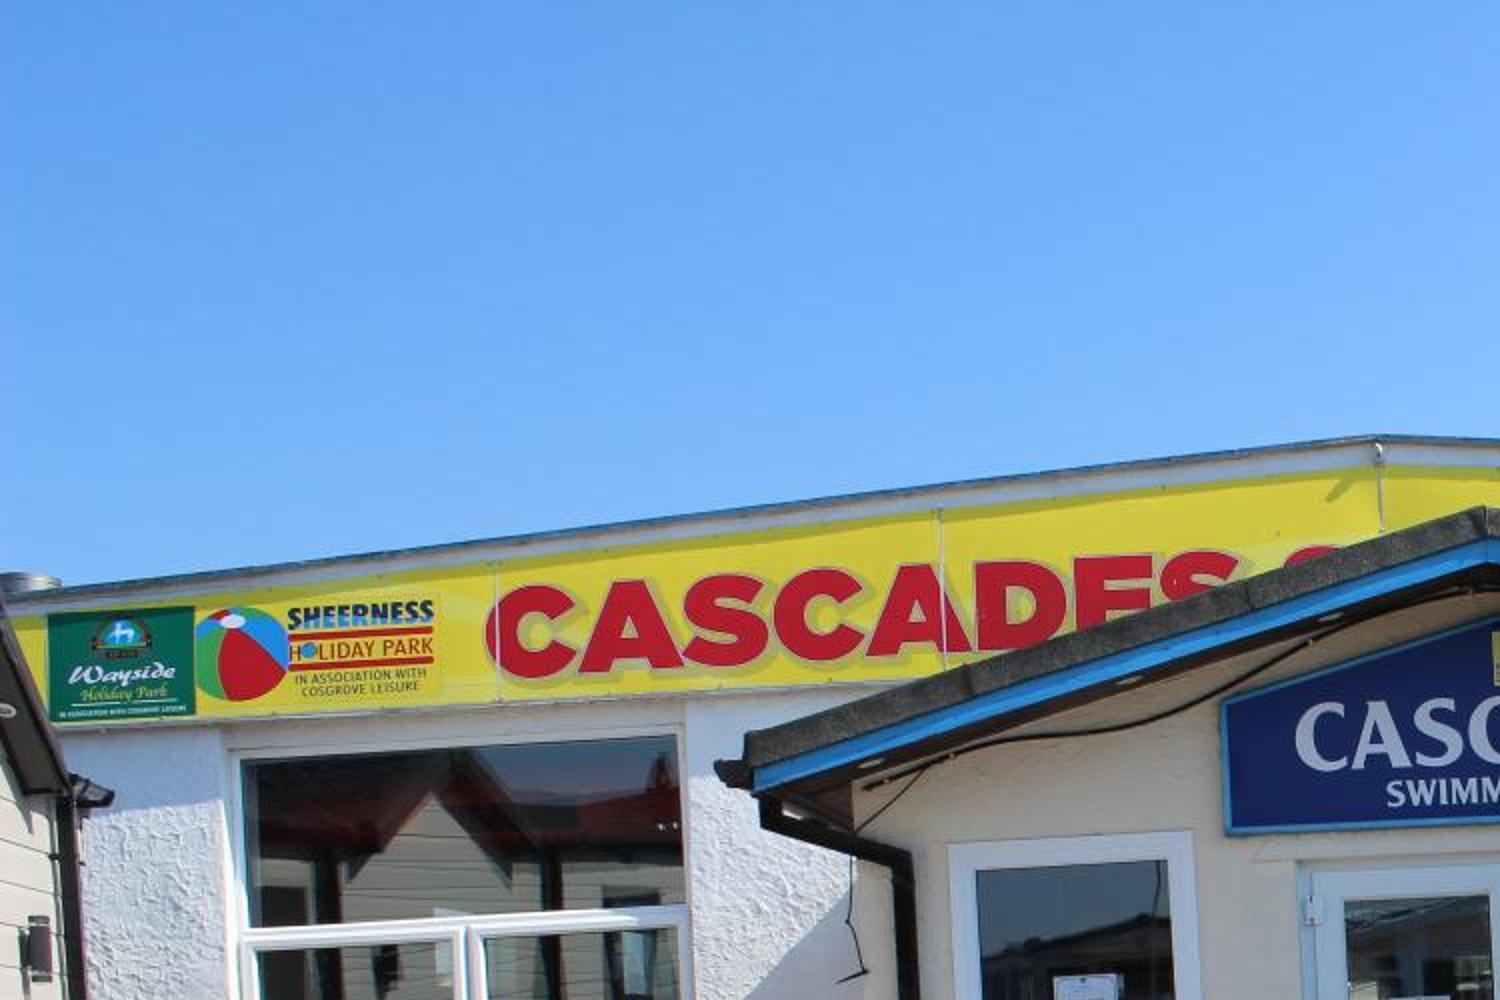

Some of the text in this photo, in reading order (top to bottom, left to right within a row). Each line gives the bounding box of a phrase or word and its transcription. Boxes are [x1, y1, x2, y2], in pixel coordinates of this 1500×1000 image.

[287, 599, 434, 631] SHEERNESS
[289, 637, 433, 661] HOLIDAY PARK
[68, 661, 176, 687] Wayside
[295, 667, 427, 685] IN ASSOCIATION WITH
[301, 684, 367, 697] COSGROVE
